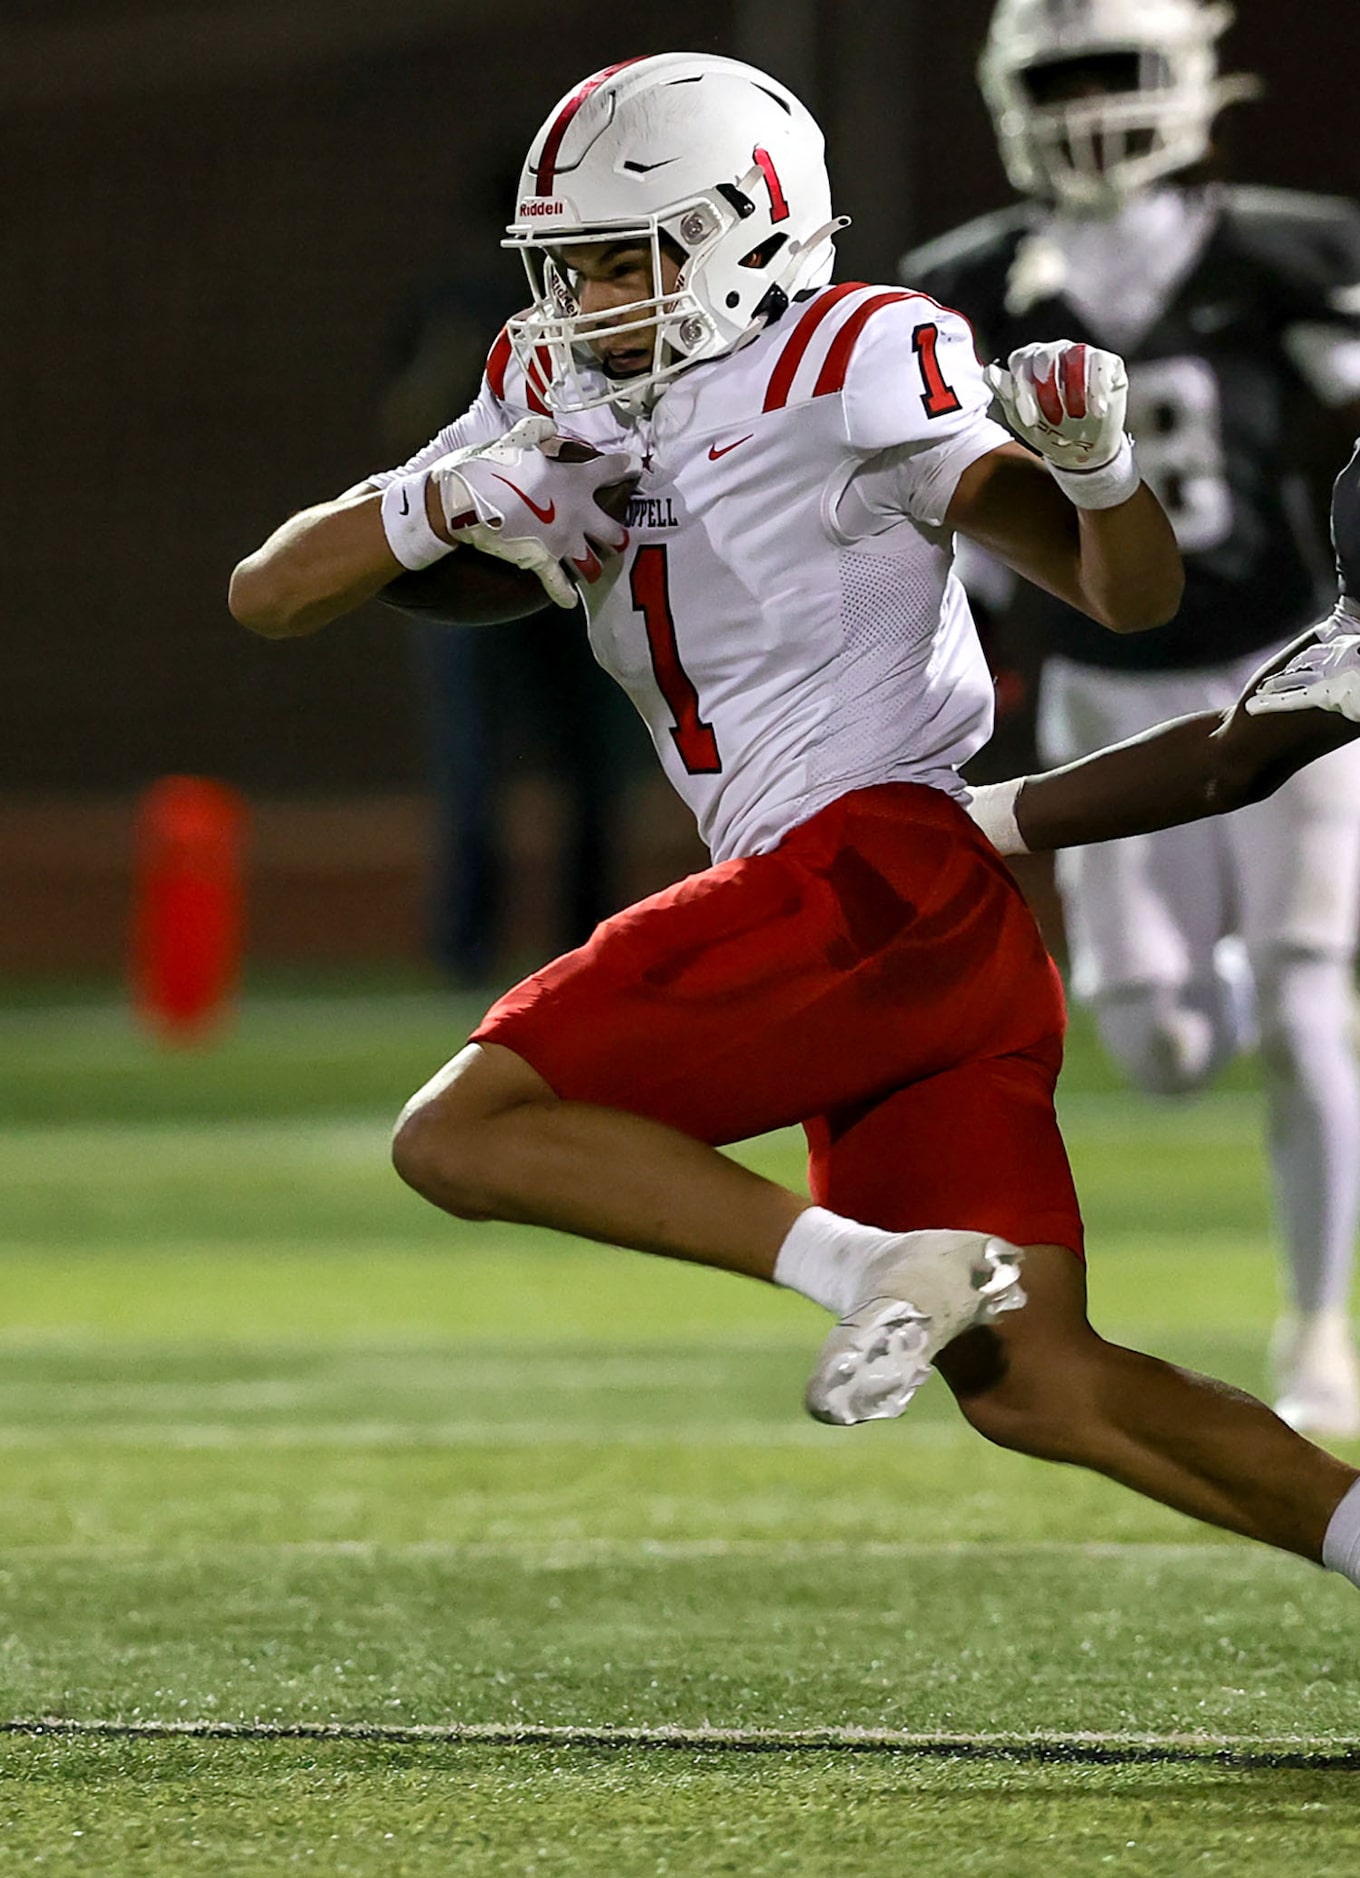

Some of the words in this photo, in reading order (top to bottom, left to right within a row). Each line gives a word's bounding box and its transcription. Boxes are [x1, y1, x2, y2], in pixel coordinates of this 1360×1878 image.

[519, 202, 564, 216] Riddell
[752, 147, 790, 225] 1
[551, 272, 579, 318] Riddel
[911, 322, 963, 420] 1
[624, 498, 678, 528] OPPELL
[629, 543, 722, 776] 1
